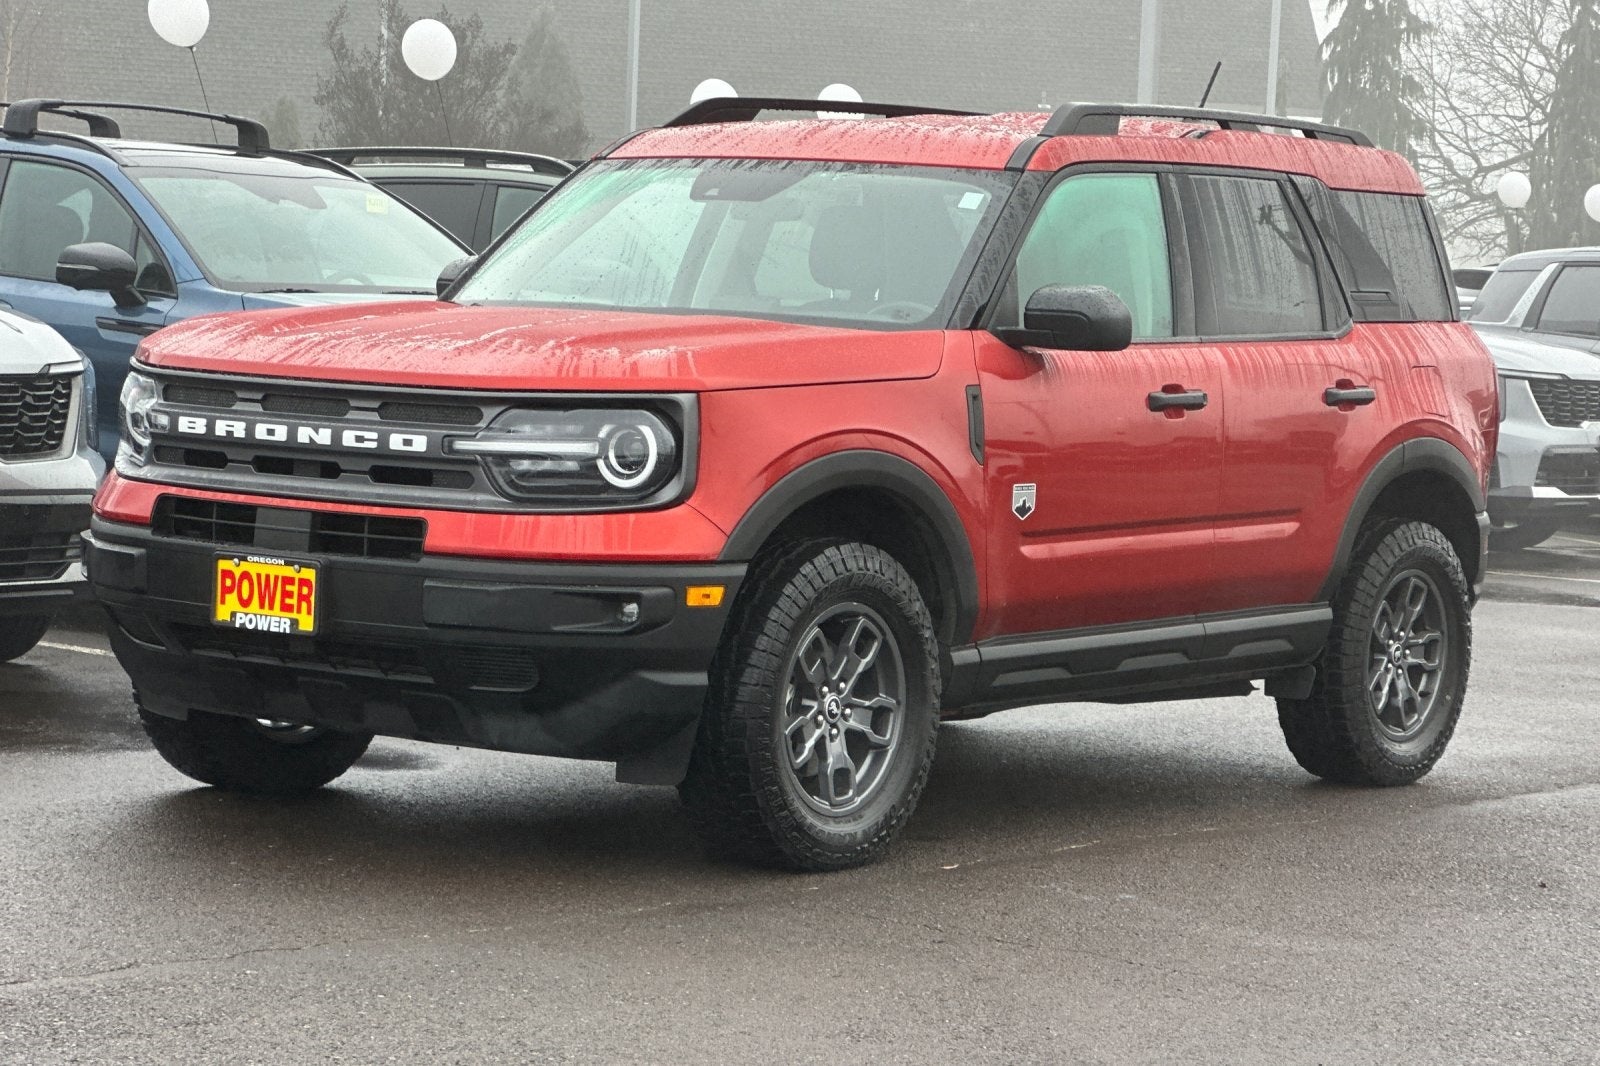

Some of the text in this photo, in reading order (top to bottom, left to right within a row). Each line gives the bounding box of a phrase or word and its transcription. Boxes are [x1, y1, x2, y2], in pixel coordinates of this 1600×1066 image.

[178, 415, 427, 452] BRONCO
[247, 556, 285, 566] OREGON
[219, 568, 314, 616] POWER
[235, 612, 291, 634] POWER
